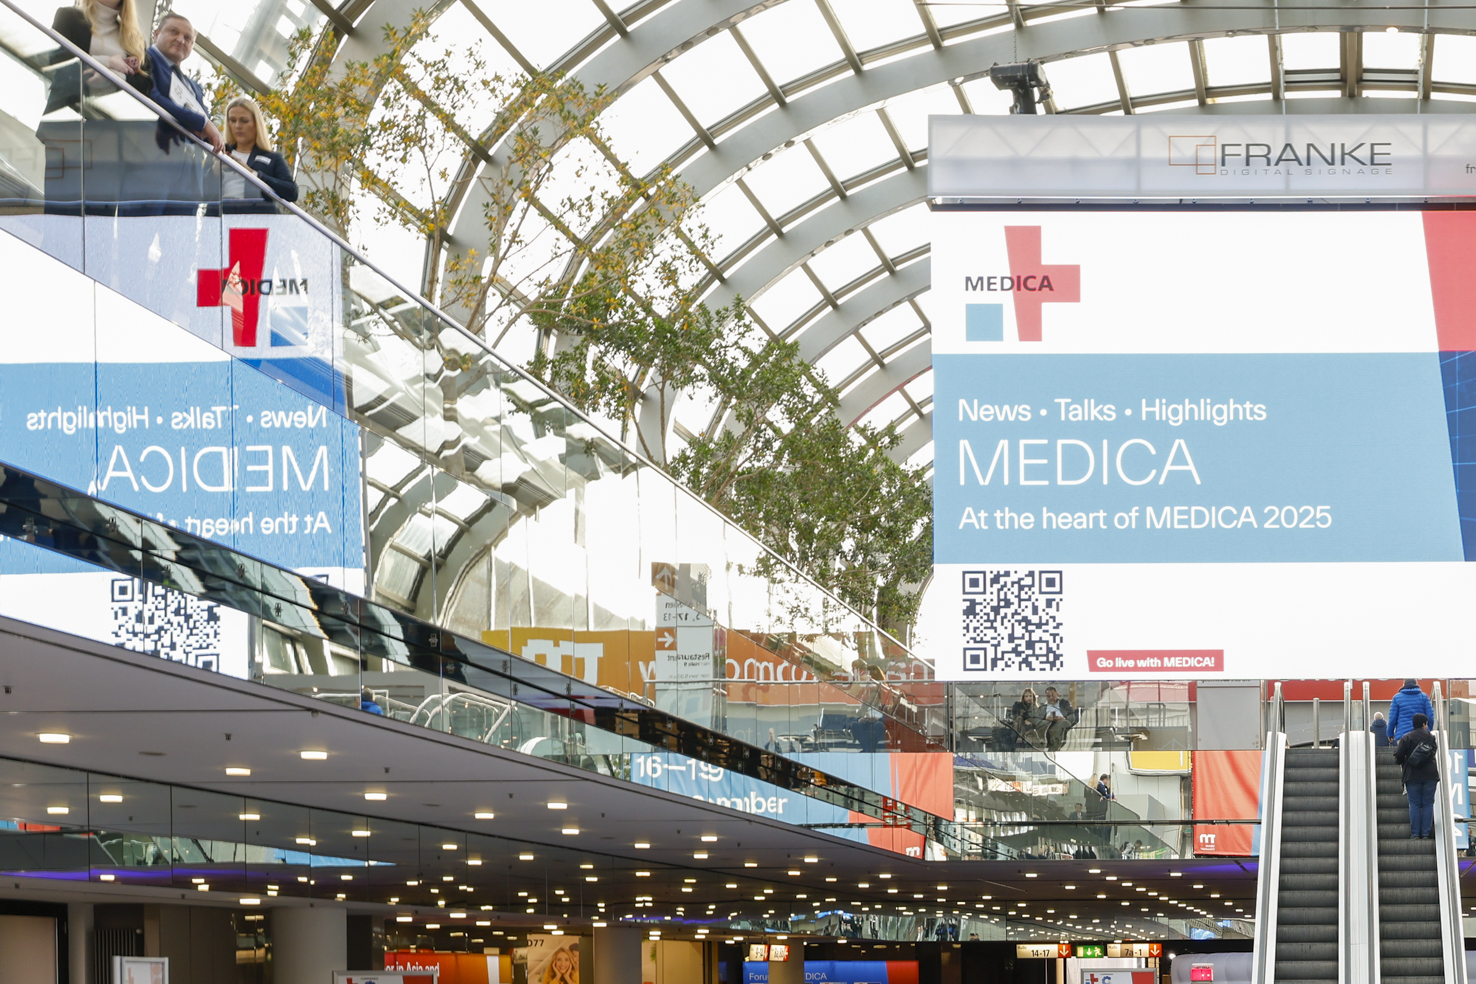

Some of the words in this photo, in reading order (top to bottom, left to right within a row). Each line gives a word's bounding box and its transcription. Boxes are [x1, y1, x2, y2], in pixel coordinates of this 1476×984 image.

[1221, 142, 1392, 167] FRANKE
[1305, 168, 1393, 176] SIGNAGE
[965, 275, 1054, 292] MEDICA
[958, 398, 1032, 422] News
[1054, 398, 1117, 422] Talks
[1141, 398, 1267, 426] Highlights
[958, 438, 1202, 486] MEDICA
[958, 507, 989, 530] At
[993, 506, 1035, 530] the
[1042, 506, 1107, 529] heart
[1113, 506, 1140, 529] of
[1146, 505, 1258, 529] MEDICA
[1263, 505, 1333, 529] 2025
[1096, 656, 1114, 668] Go
[1115, 656, 1135, 668] live
[1136, 656, 1162, 668] with
[1163, 656, 1215, 668] MEDICA!
[1031, 950, 1050, 958] 14-17
[749, 972, 768, 980] Foru
[804, 972, 828, 980] DICA
